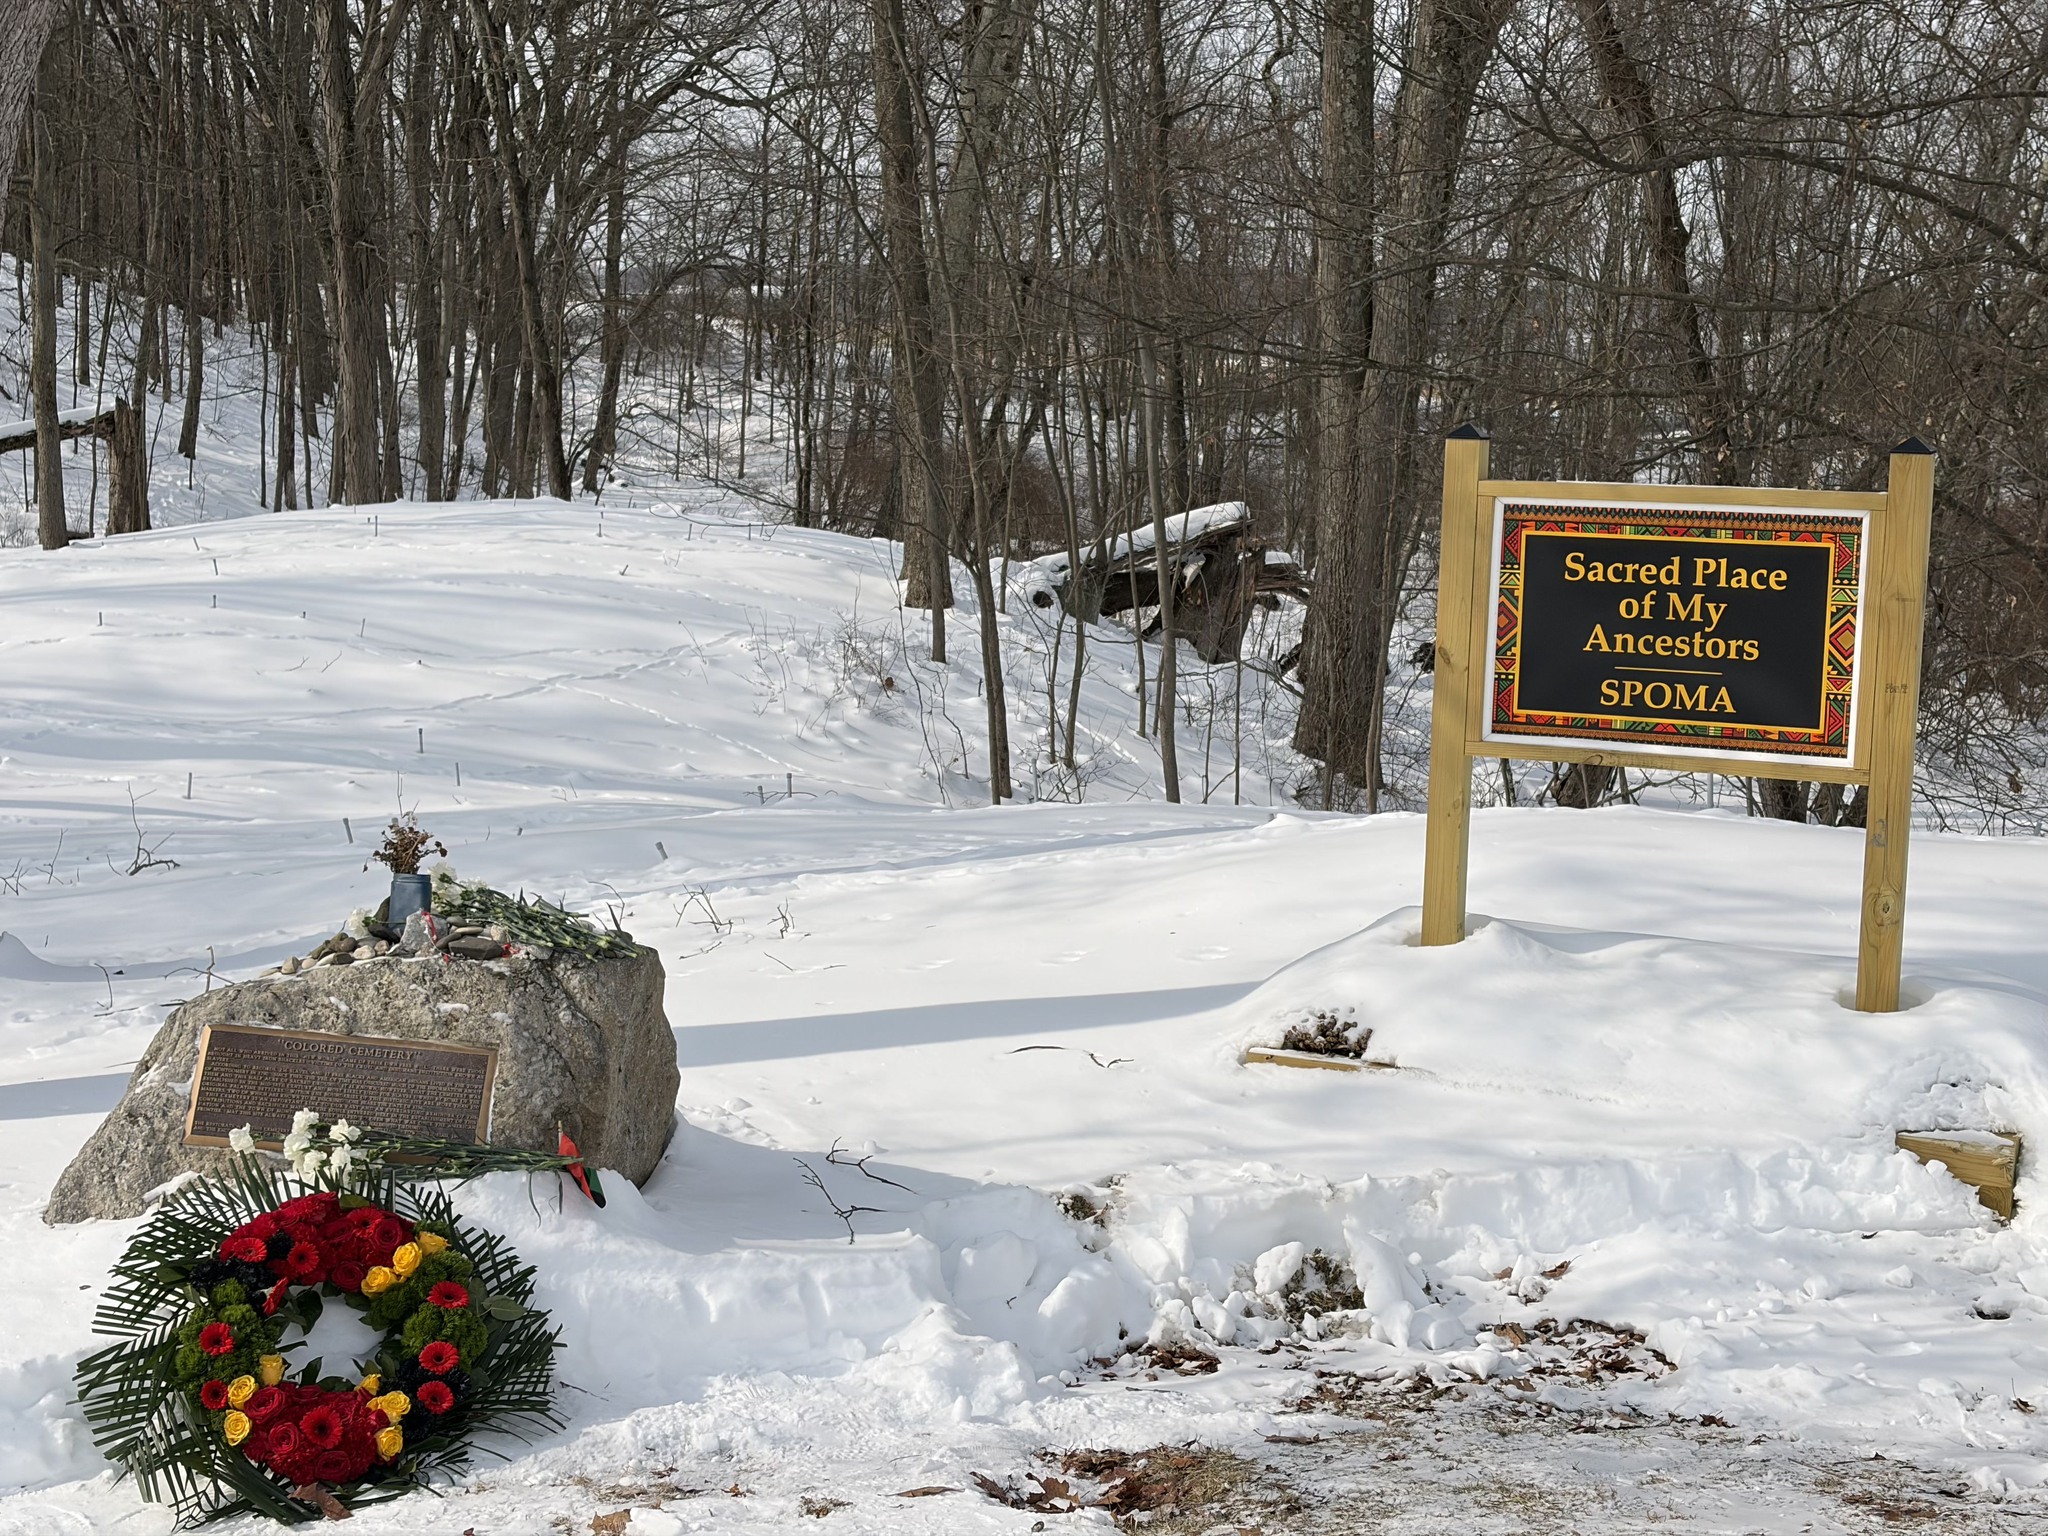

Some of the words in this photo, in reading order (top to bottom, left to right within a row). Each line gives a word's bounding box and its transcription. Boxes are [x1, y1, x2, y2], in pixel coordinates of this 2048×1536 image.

[1564, 552, 1682, 586] Sacred
[1693, 557, 1788, 591] Place
[1618, 590, 1657, 620] of
[1666, 592, 1728, 632] My
[1583, 623, 1760, 662] Ancestors
[1600, 679, 1737, 714] SPOMA
